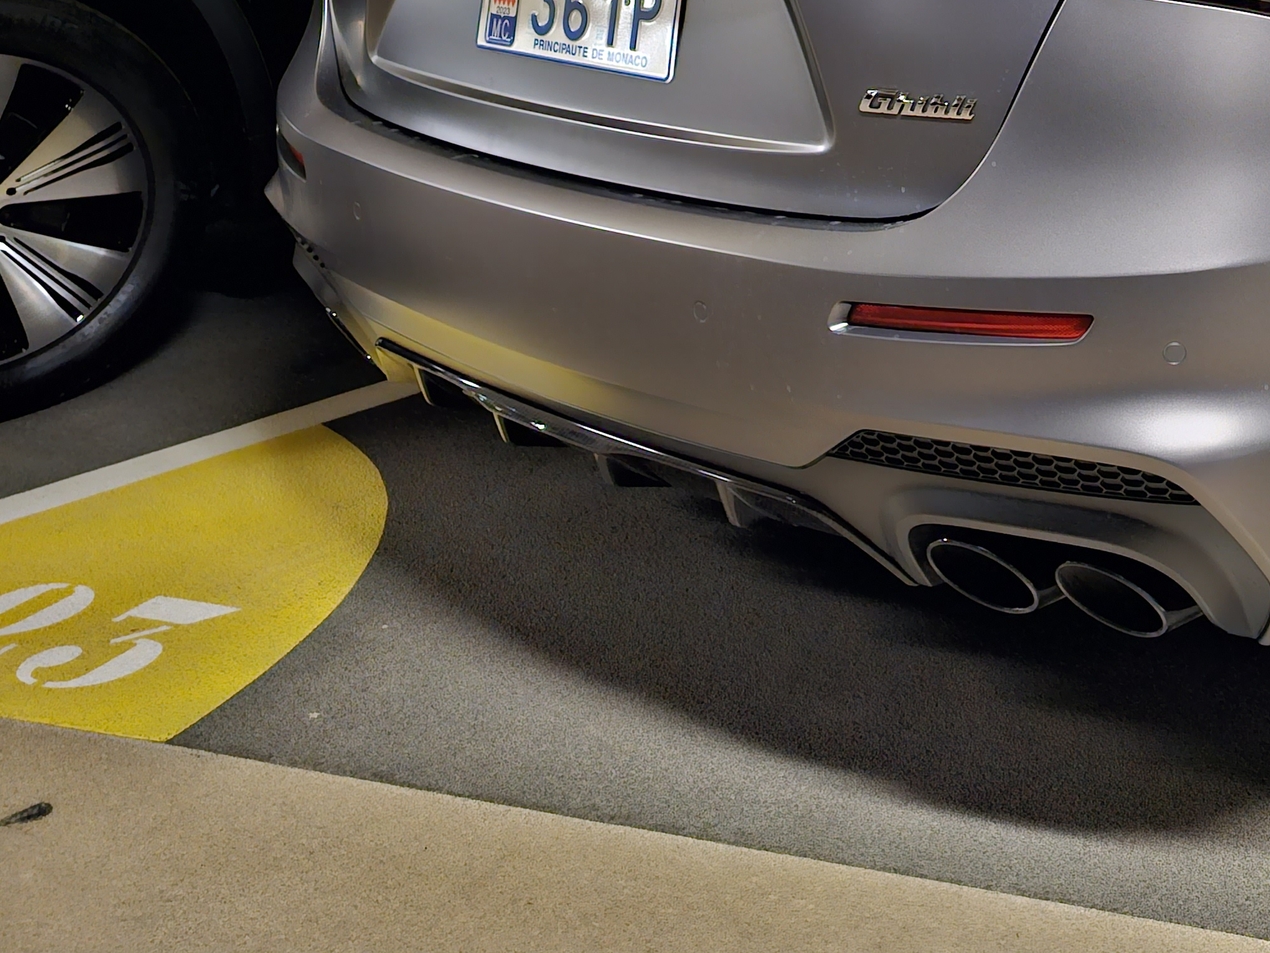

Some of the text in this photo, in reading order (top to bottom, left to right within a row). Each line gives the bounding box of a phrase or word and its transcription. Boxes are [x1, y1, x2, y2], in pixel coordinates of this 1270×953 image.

[496, 5, 511, 15] 2023
[490, 16, 512, 39] MC
[533, 38, 648, 68] PRINCIPAUTE DE MONACO
